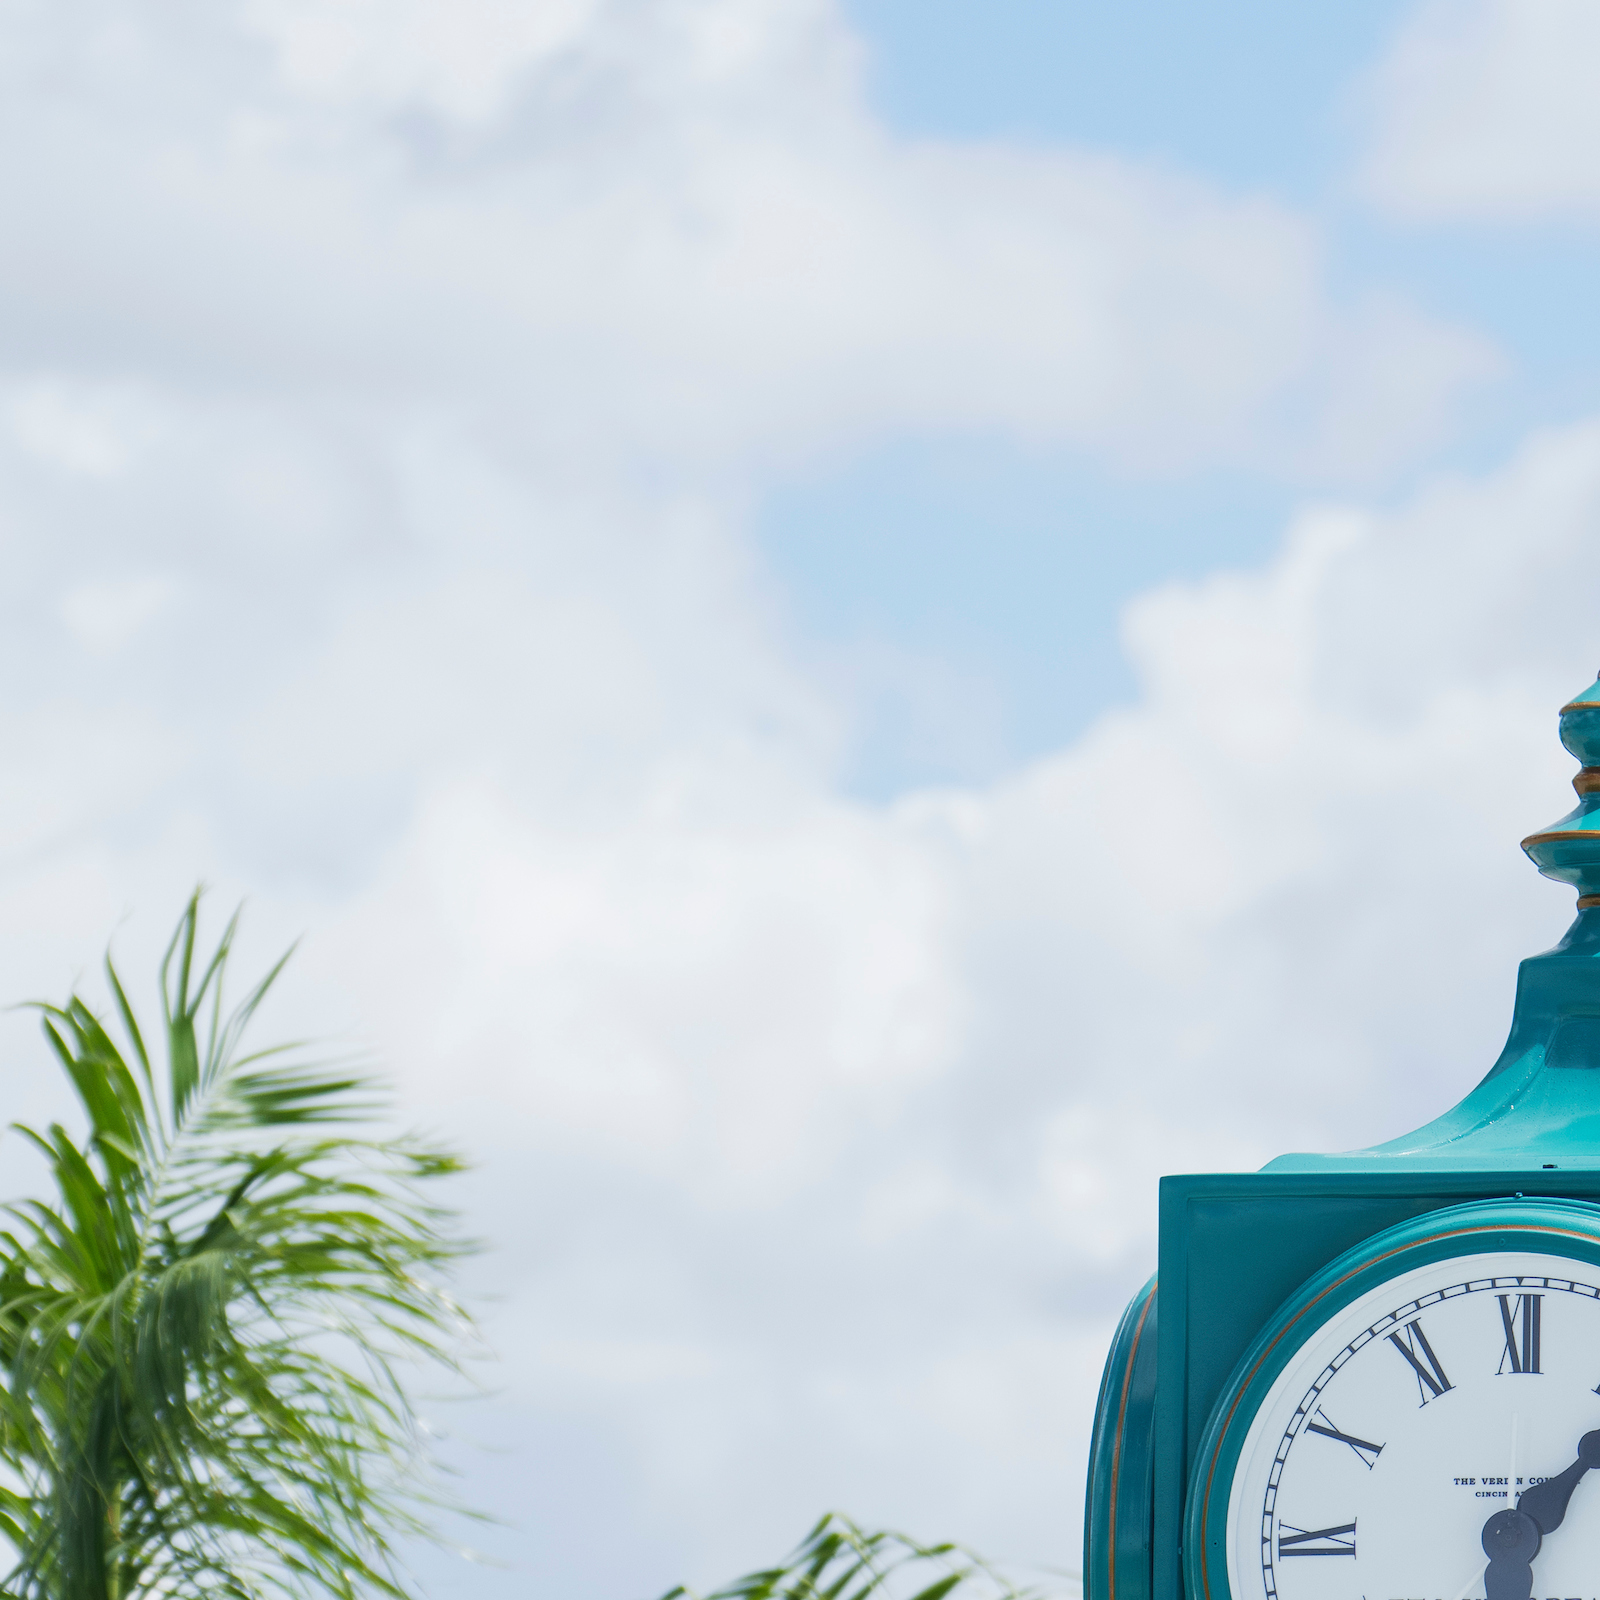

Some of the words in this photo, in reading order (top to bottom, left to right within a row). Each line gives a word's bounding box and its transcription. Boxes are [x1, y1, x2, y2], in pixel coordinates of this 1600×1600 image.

[1383, 1317, 1457, 1409] XI
[1494, 1294, 1545, 1376] XII
[1304, 1404, 1387, 1471] X
[1453, 1477, 1476, 1486] THE
[1481, 1477, 1523, 1486] VERN
[1278, 1517, 1357, 1561] IX
